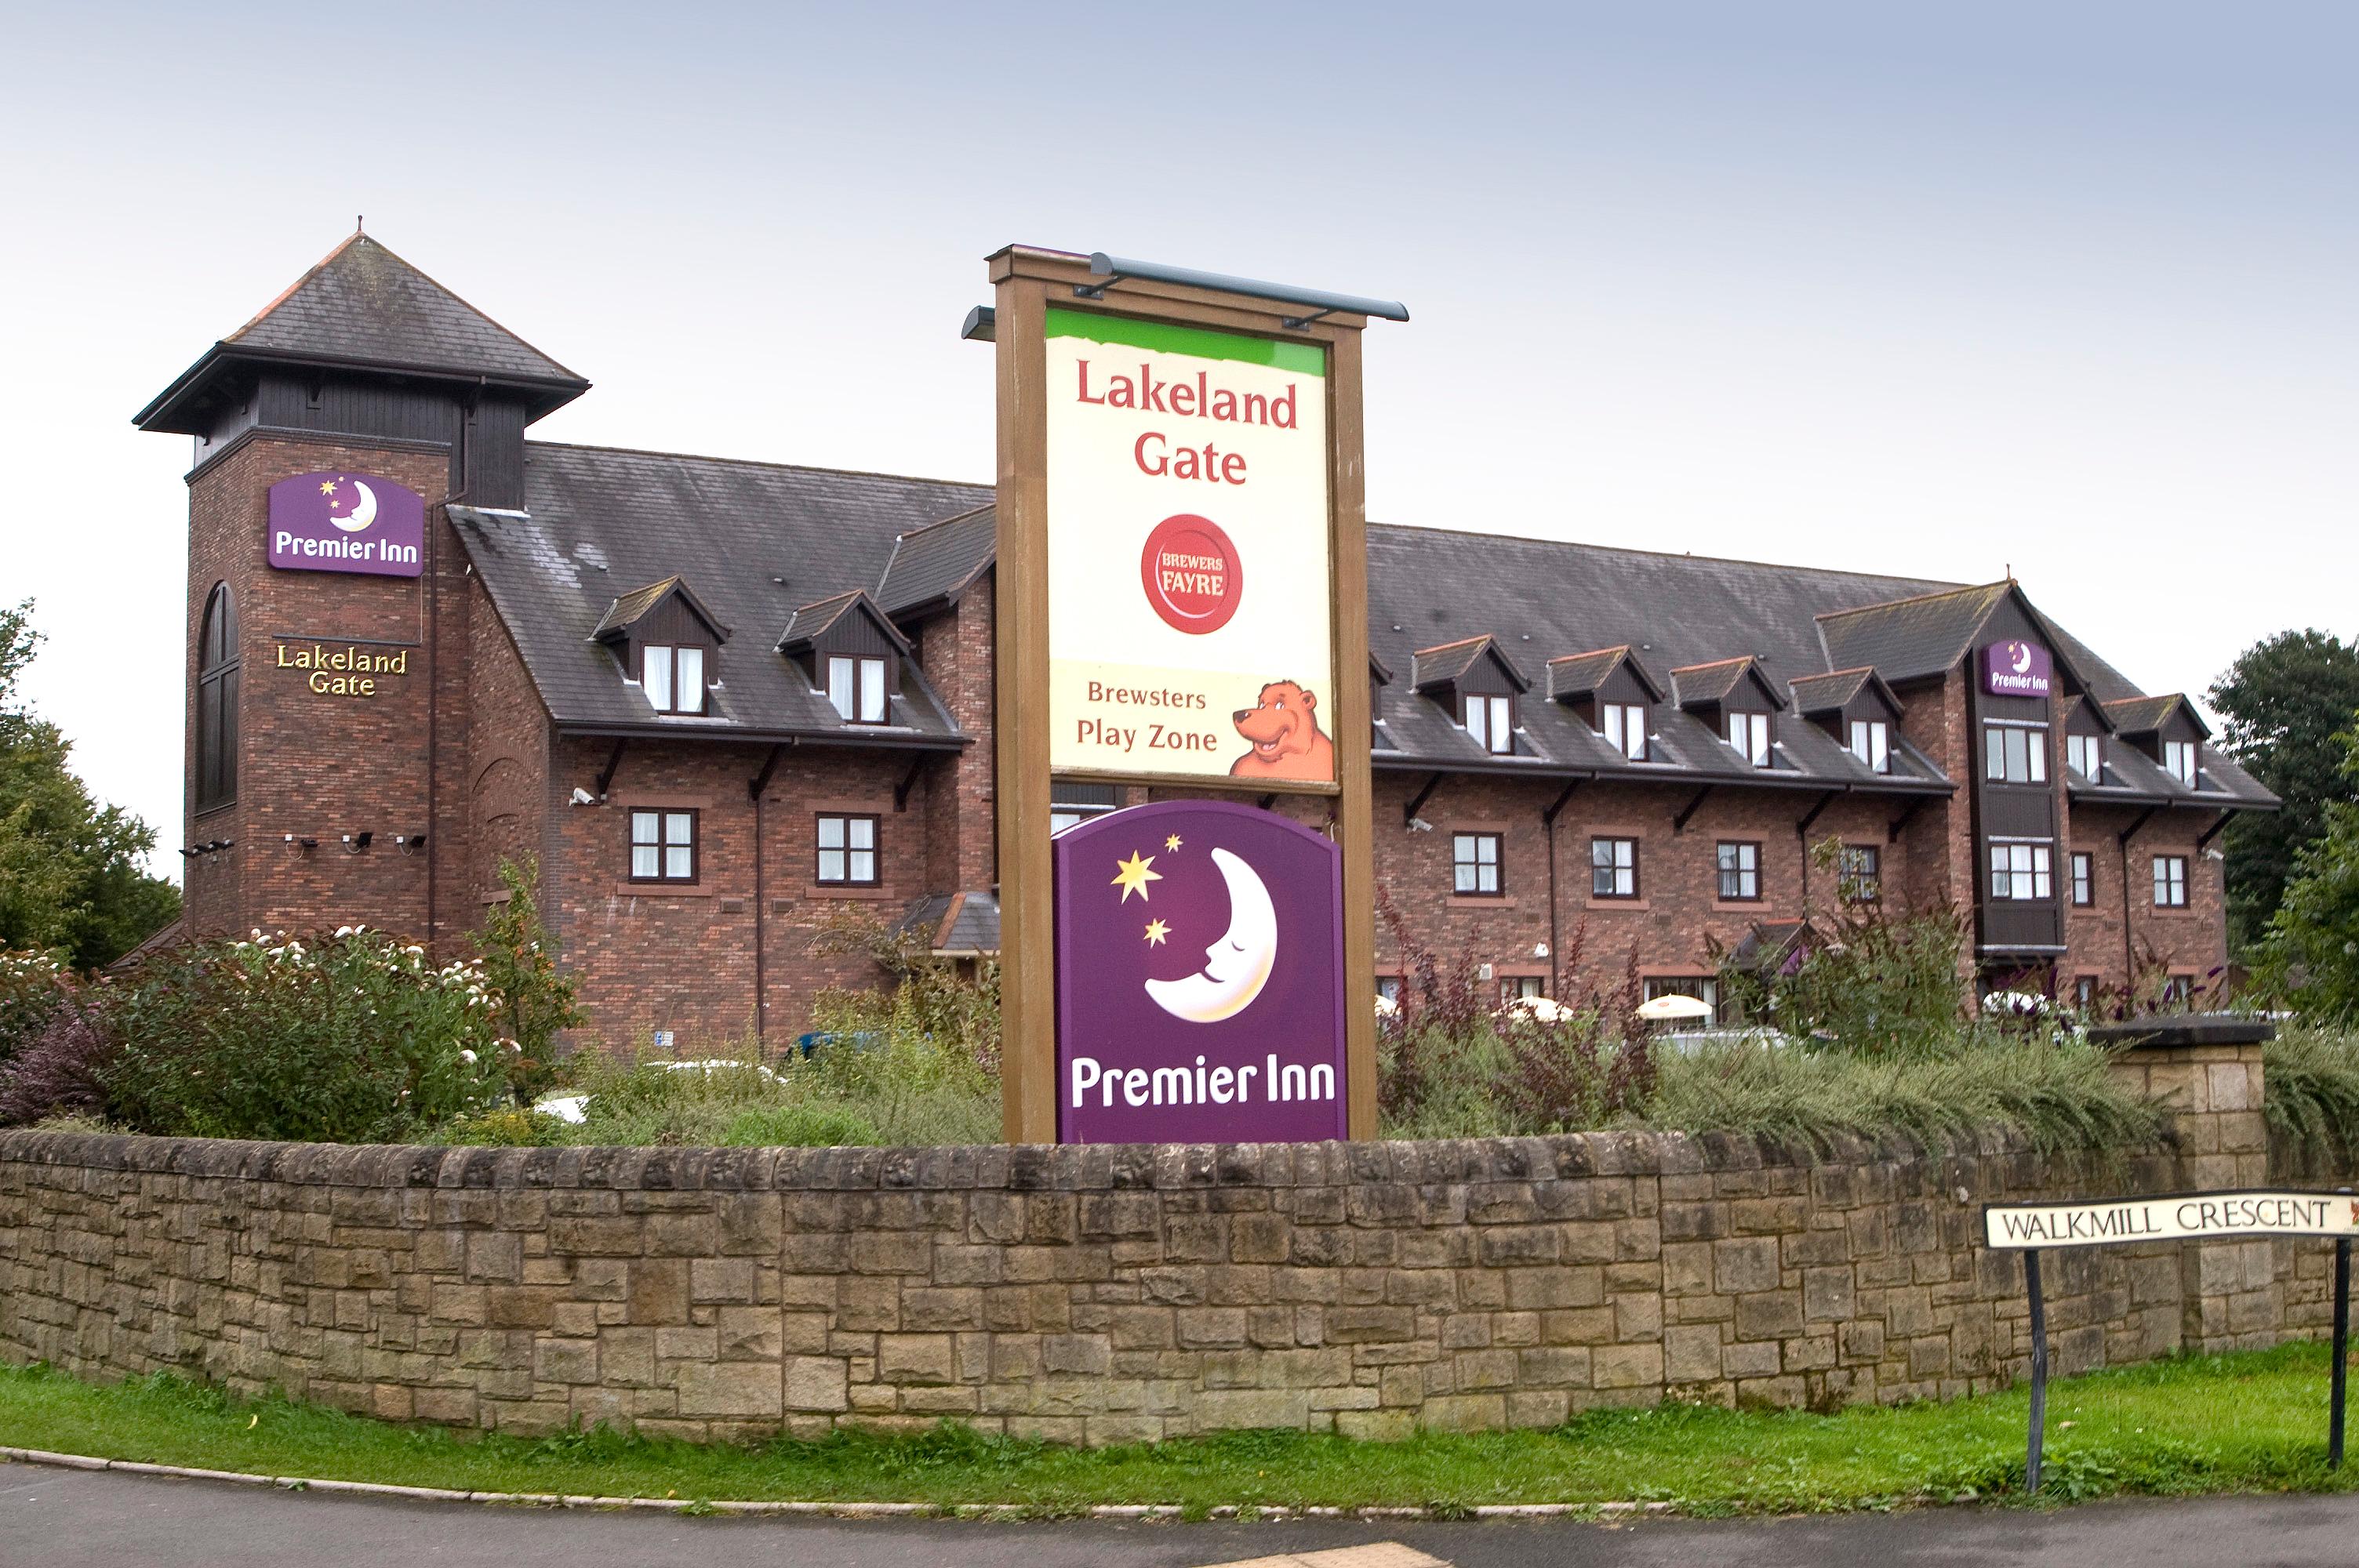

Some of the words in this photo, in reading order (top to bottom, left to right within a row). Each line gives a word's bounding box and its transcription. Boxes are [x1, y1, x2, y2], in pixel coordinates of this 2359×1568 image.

[1076, 358, 1299, 430] Lakeland
[1134, 431, 1247, 485] Gate
[276, 531, 376, 559] Premier
[380, 539, 417, 563] Inn
[1162, 553, 1223, 572] BREWERS
[1162, 571, 1224, 597] FAYRE
[277, 644, 407, 674] Lakeland
[309, 670, 376, 696] Gate
[1088, 681, 1206, 710] Brewsters
[1992, 672, 2031, 688] Premier
[2033, 675, 2048, 690] Inn
[1077, 718, 1136, 753] Play
[1148, 724, 1218, 752] Zone
[1071, 1055, 1258, 1108] Premier
[1267, 1054, 1335, 1101] Inn
[2002, 1207, 2162, 1240] WALKMILL
[2176, 1200, 2332, 1230] CRESCENT
